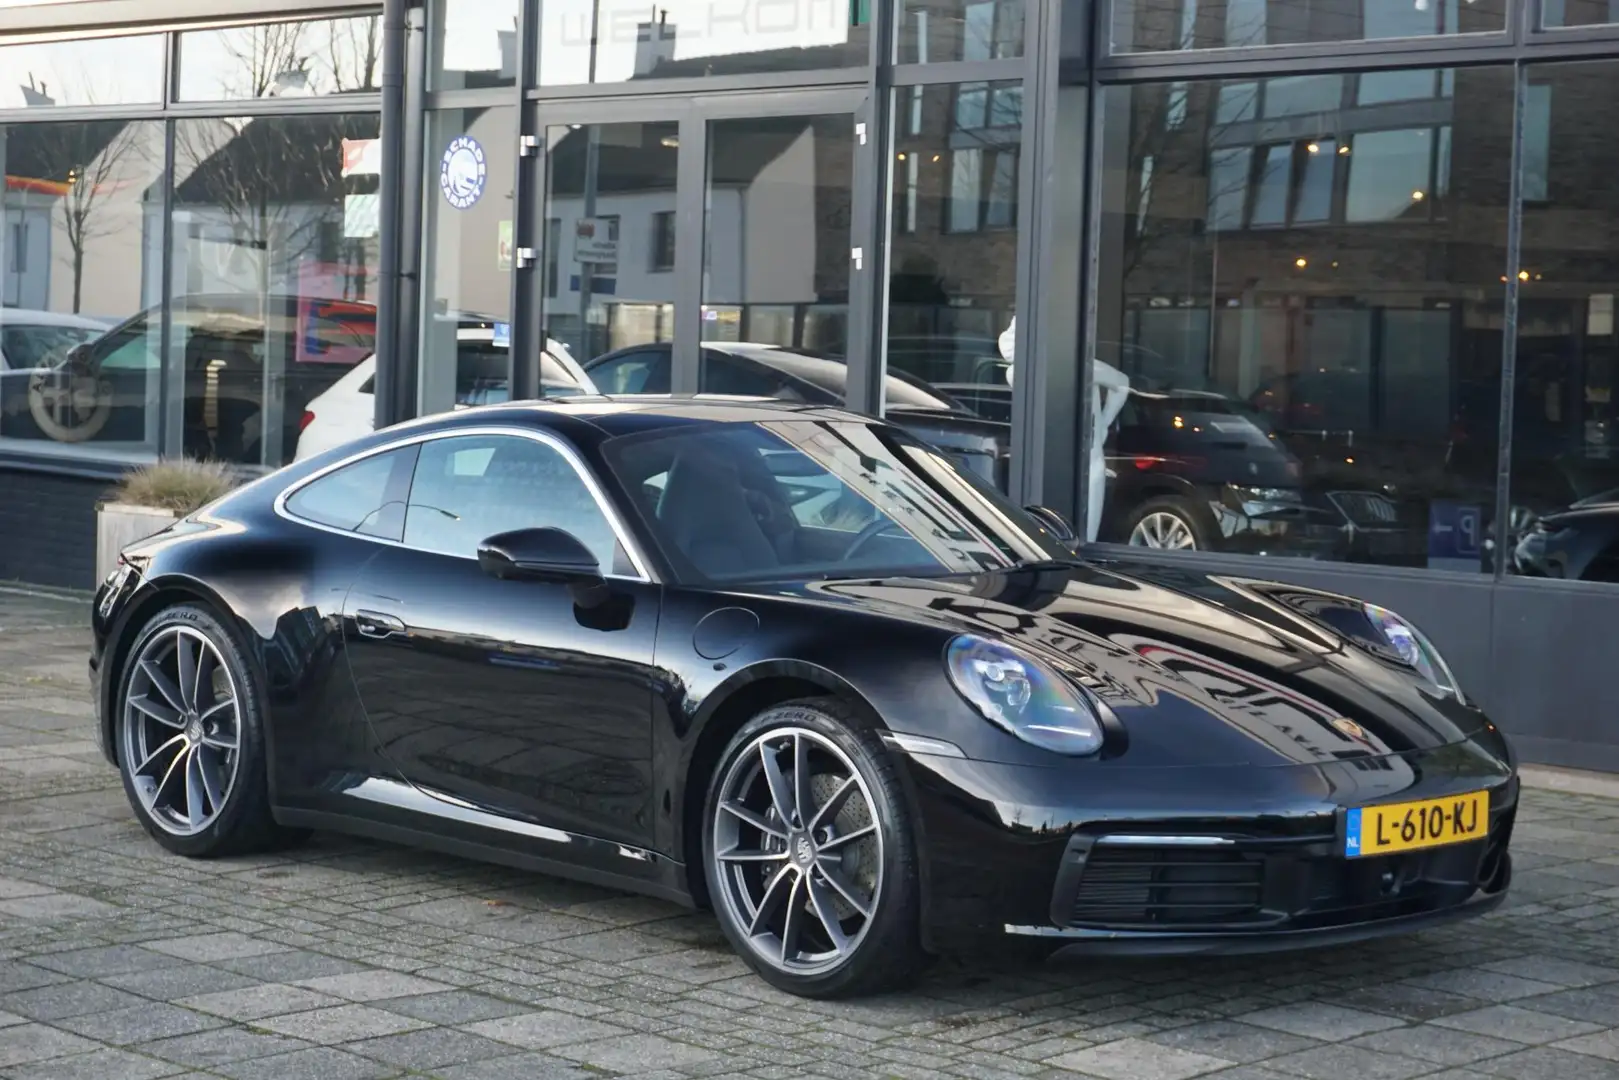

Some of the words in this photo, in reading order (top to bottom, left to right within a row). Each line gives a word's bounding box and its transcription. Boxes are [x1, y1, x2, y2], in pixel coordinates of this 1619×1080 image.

[443, 136, 486, 176] SCHADE
[440, 173, 481, 208] GARANT
[1376, 800, 1478, 846] L-610-KJ
[1346, 836, 1359, 848] NL
